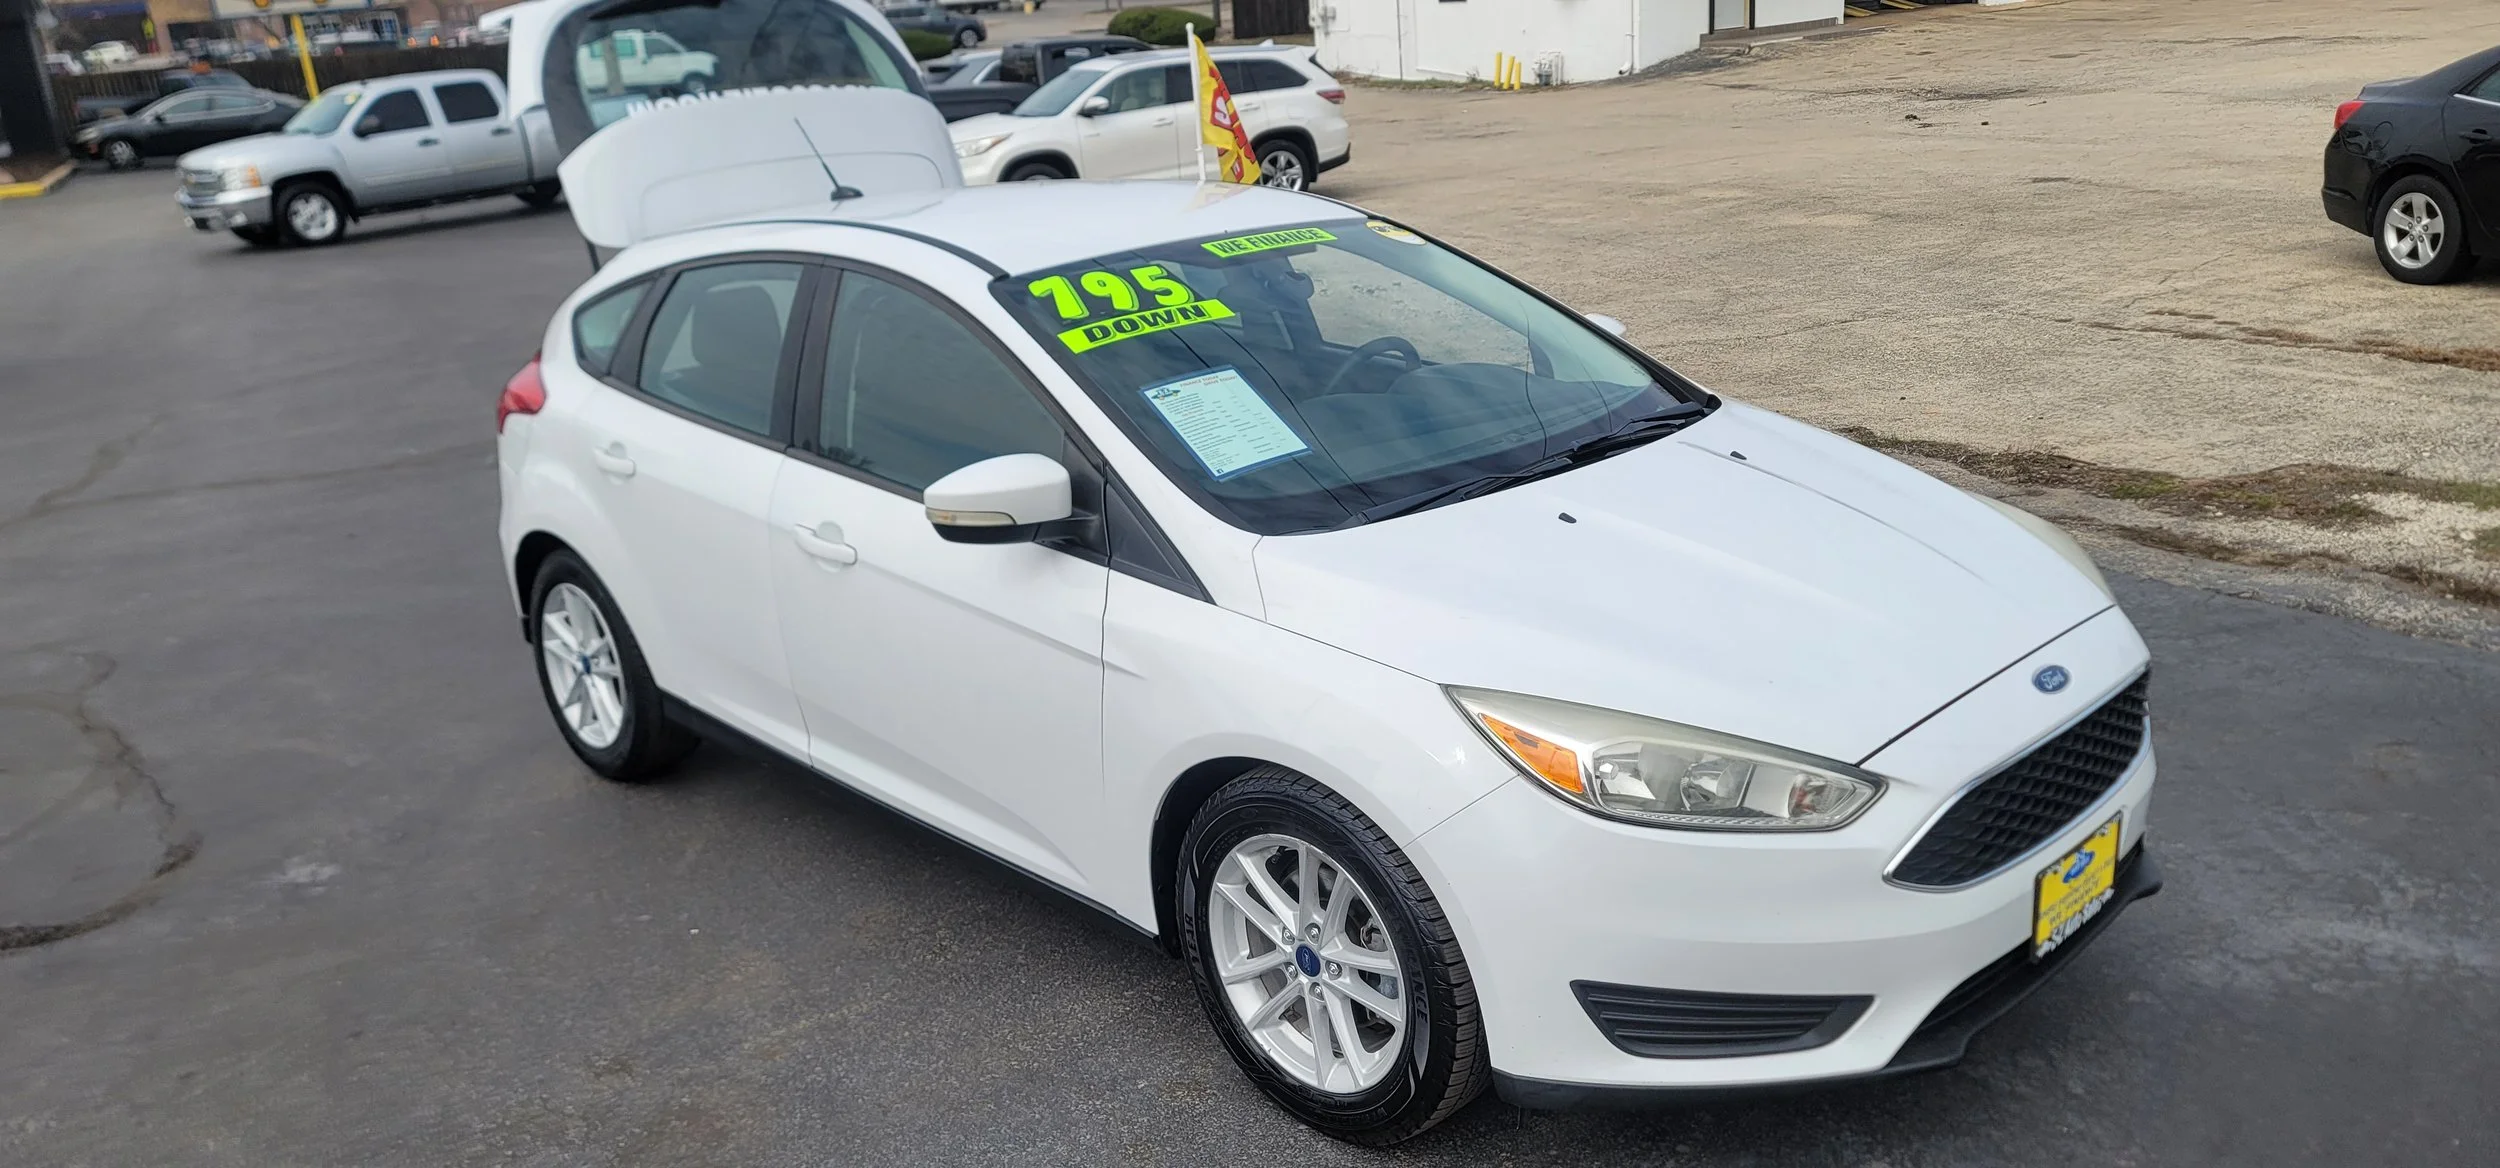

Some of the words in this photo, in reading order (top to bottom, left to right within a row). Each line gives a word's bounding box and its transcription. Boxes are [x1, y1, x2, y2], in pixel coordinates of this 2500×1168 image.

[1212, 239, 1248, 254] WE
[1245, 229, 1325, 249] FINANCE
[1027, 264, 1195, 319] 795
[1082, 304, 1211, 344] DOWN
[2040, 669, 2066, 690] Ford
